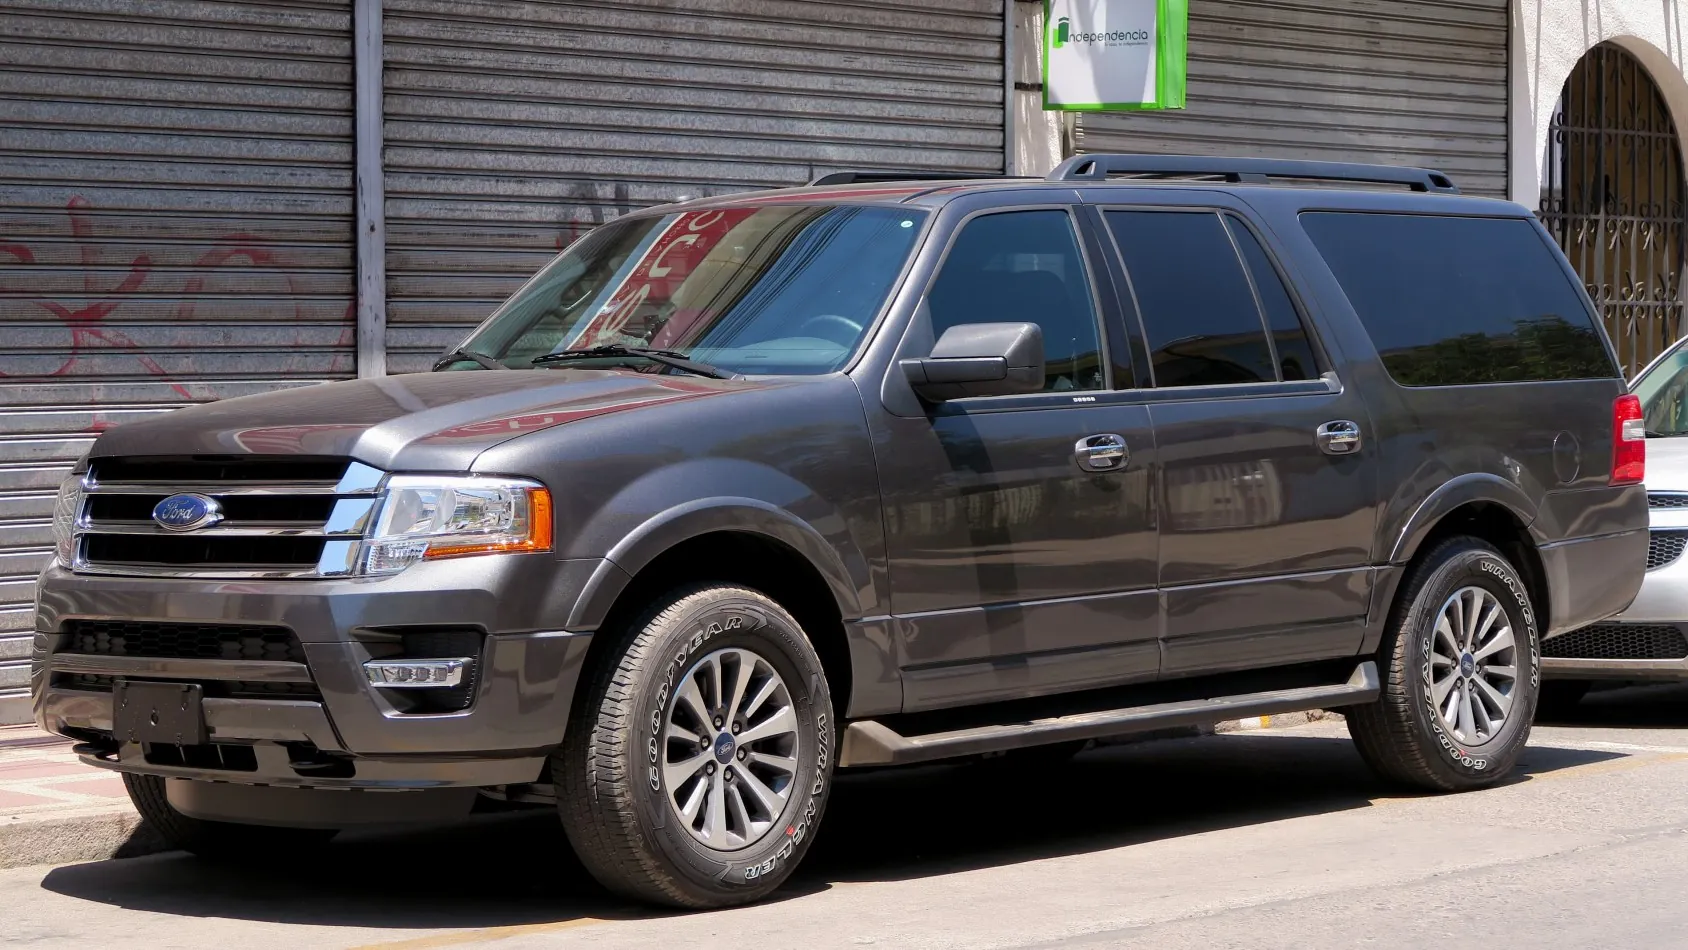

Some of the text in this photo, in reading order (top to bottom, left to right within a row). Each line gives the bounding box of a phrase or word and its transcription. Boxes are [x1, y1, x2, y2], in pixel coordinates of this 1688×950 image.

[162, 501, 196, 519] Ford
[1480, 560, 1539, 688] WRANGLER
[649, 616, 743, 791] GOODYEAR
[1422, 638, 1487, 770] GOODYEAR
[744, 712, 829, 880] WRANGLER
